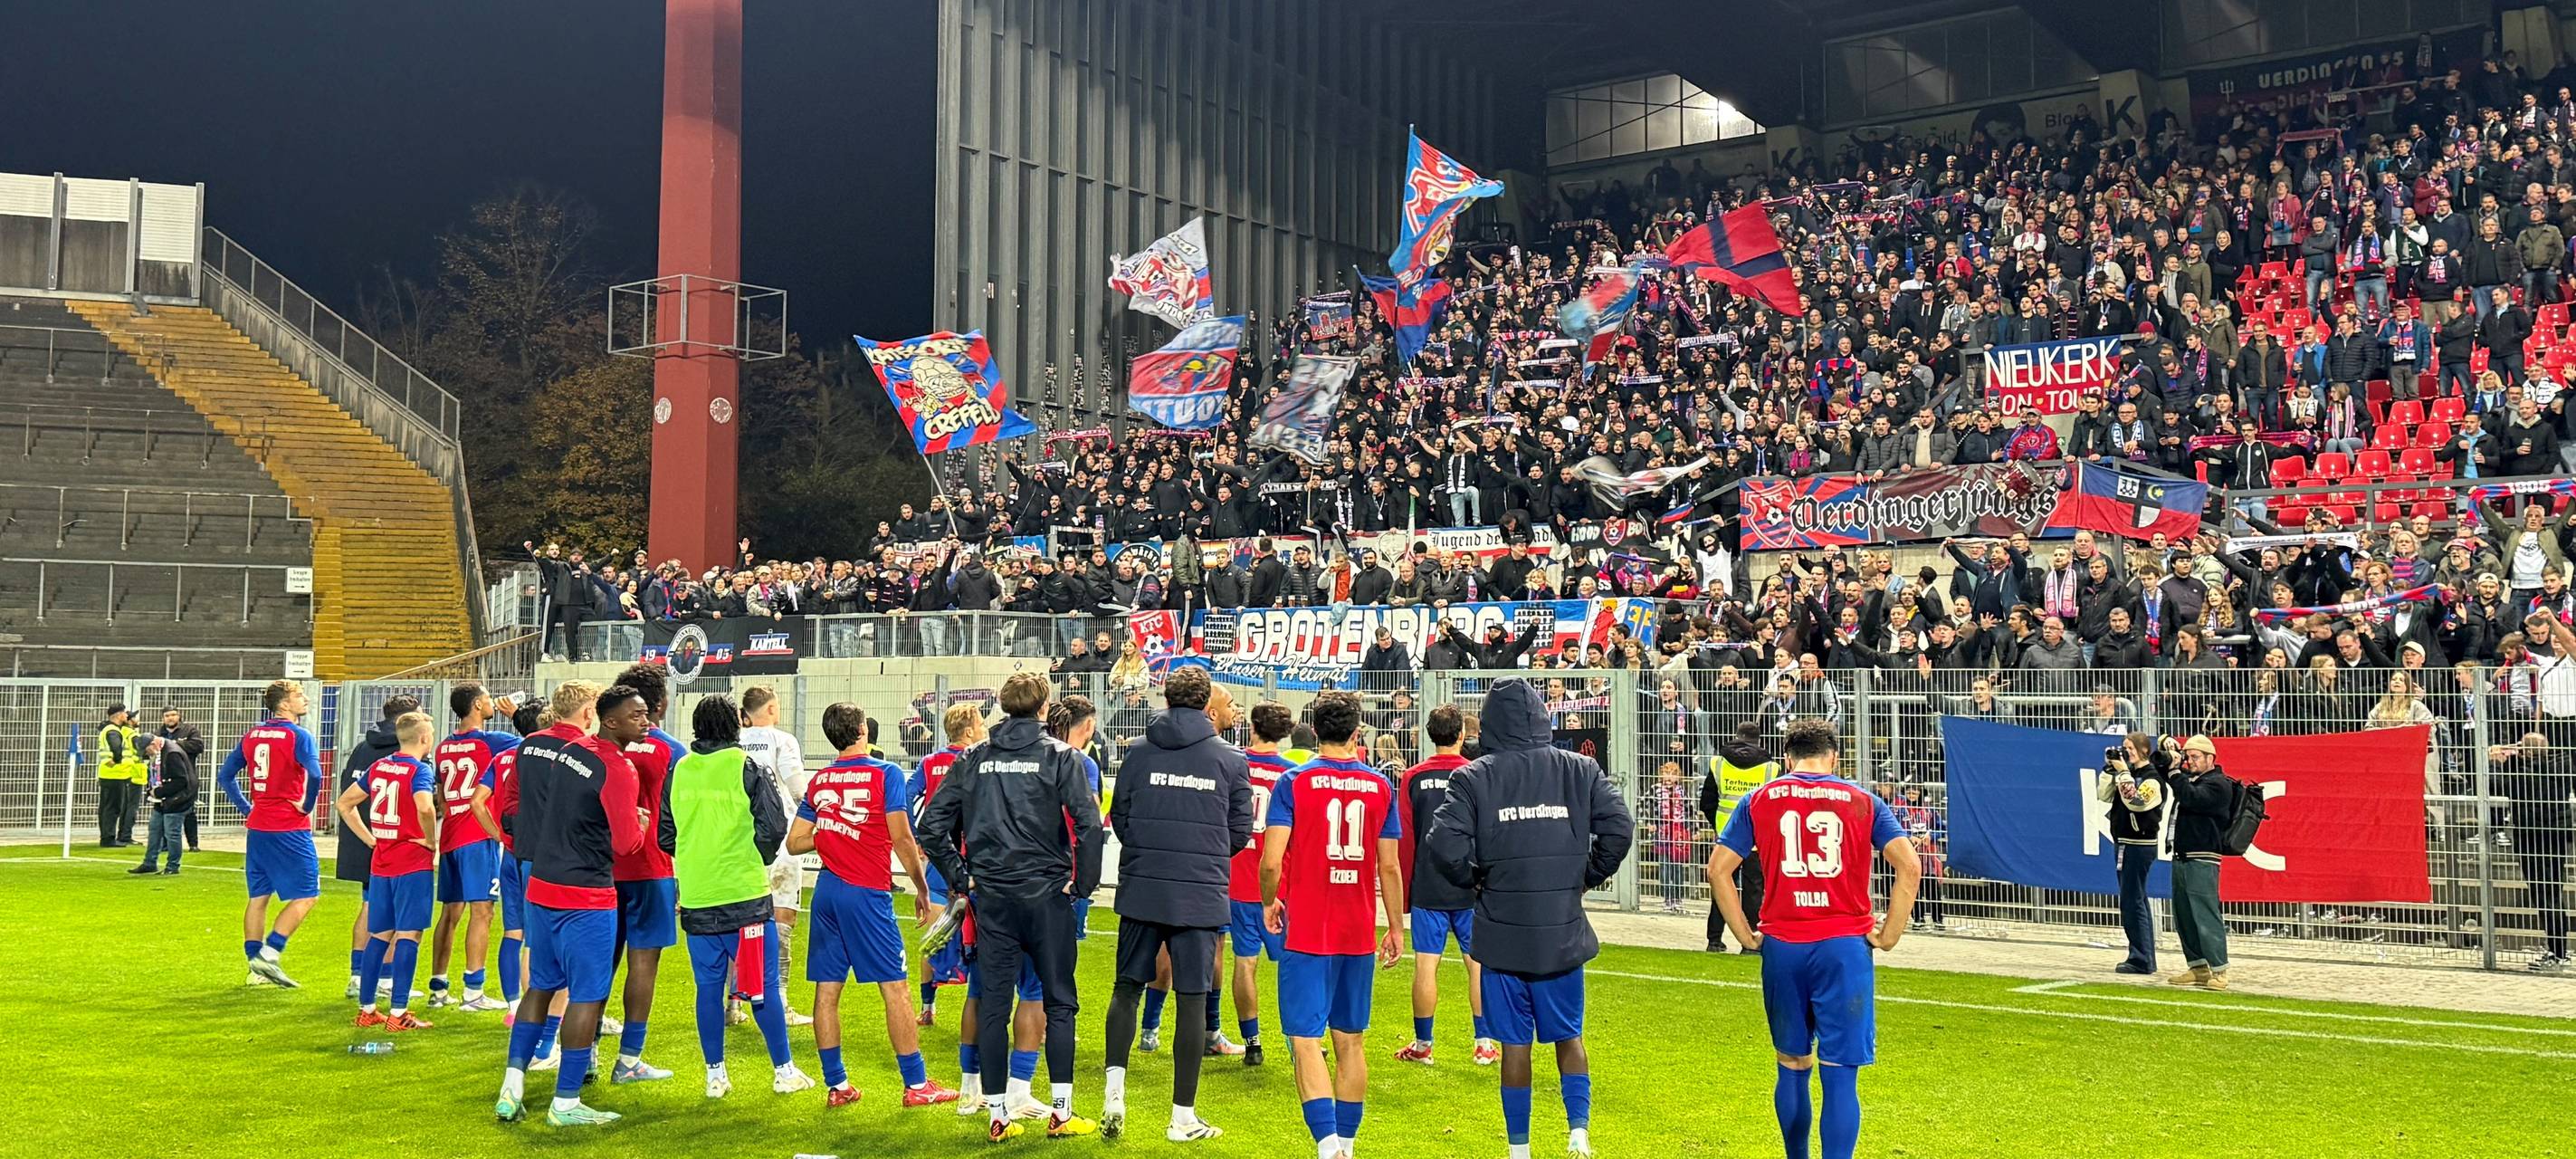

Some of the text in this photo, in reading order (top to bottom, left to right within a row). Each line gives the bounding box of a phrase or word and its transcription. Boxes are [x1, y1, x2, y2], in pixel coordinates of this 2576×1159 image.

[2105, 94, 2138, 136] K
[1984, 338, 2119, 388] NIEUKERK
[2002, 393, 2032, 416] ON
[924, 398, 1002, 440] CREFELD
[1430, 532, 1502, 549] Jugend de
[644, 647, 730, 662] 19 05
[1279, 654, 1351, 683] Heimat
[254, 743, 271, 780] 9
[979, 760, 1040, 774] KFC Uerdingen
[440, 757, 478, 801] 22
[829, 771, 872, 783] Uerdingen
[1150, 772, 1216, 792] KFC Uerdingen
[1311, 776, 1379, 794] KFC Uerdingen
[369, 777, 401, 826] 21
[1768, 785, 1852, 802] KFC Uerdingen
[813, 789, 872, 826] 25
[1498, 804, 1569, 822] KFC Uerdingen
[1326, 798, 1366, 861] 11
[1779, 810, 1844, 878] 13
[1794, 891, 1830, 907] TOLBA
